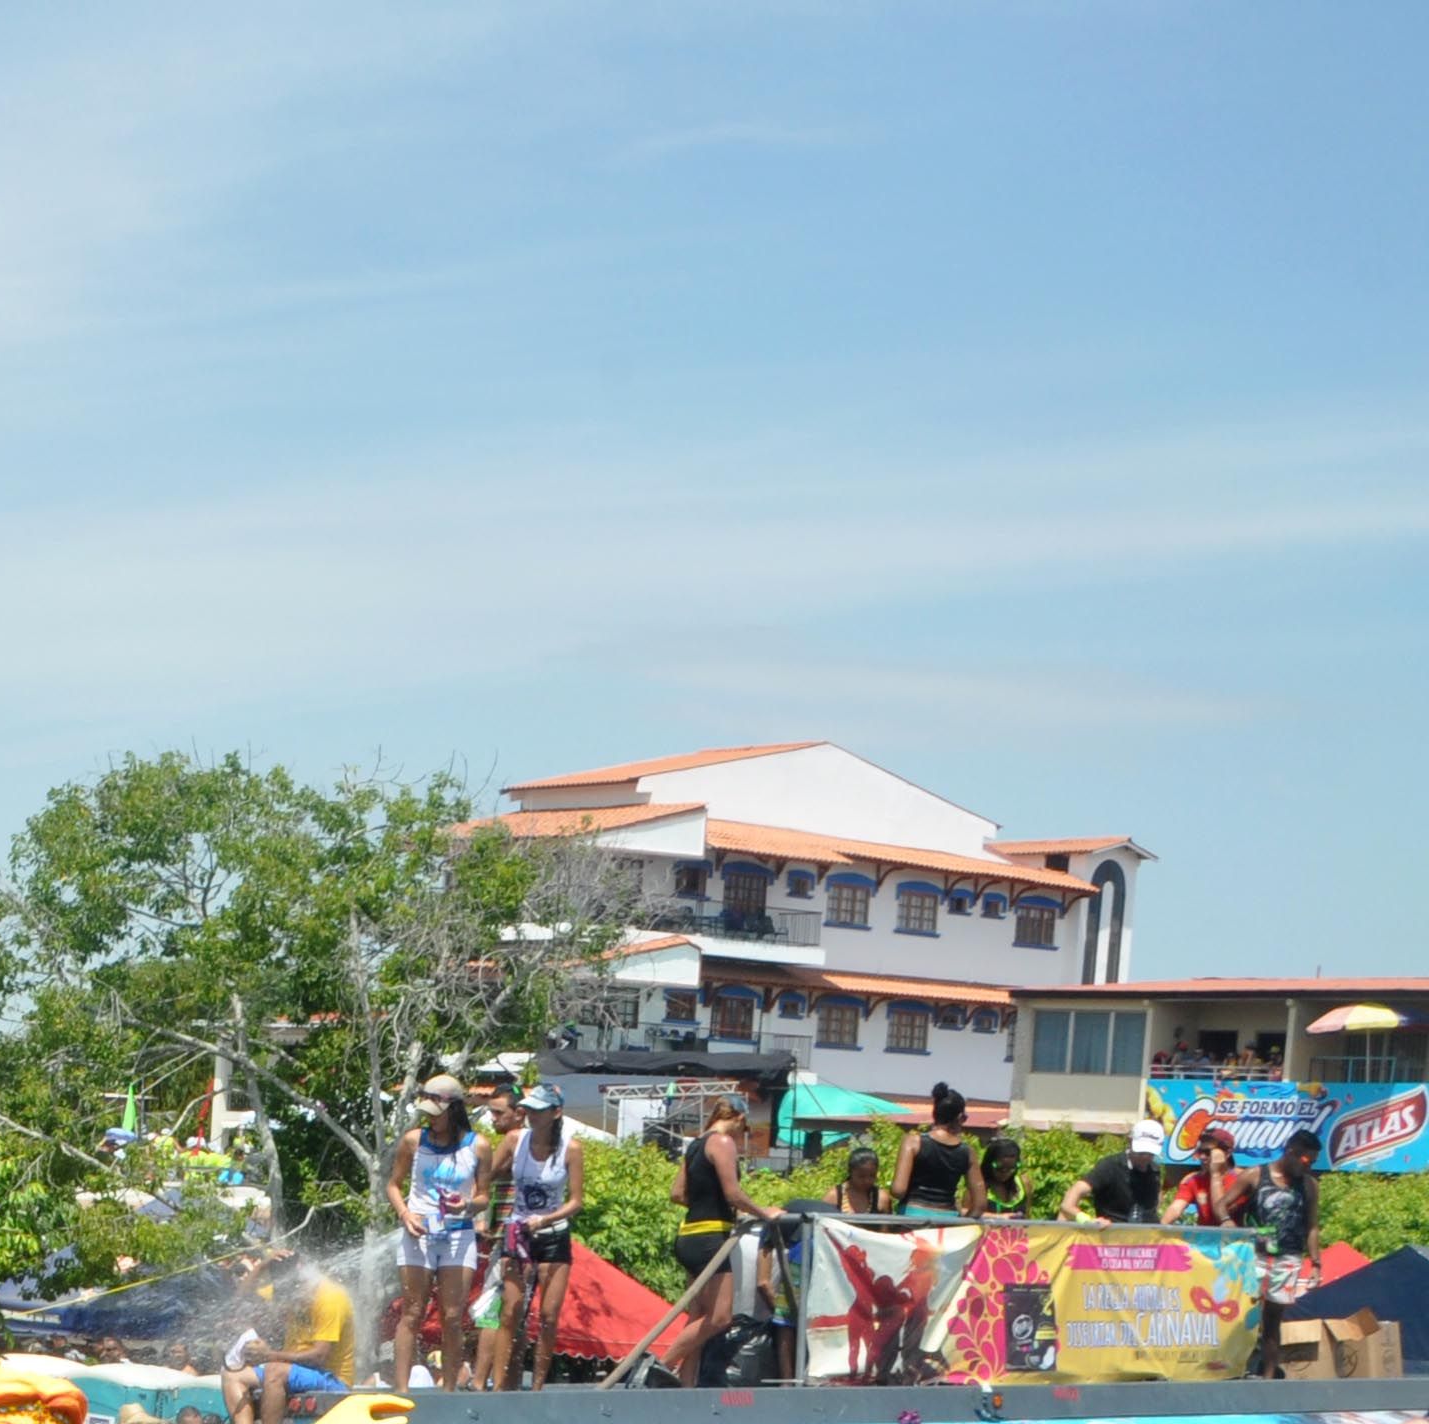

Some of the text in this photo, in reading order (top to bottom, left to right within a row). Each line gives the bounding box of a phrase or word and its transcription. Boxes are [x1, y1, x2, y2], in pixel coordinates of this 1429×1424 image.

[1218, 1100, 1238, 1114] SE
[1297, 1101, 1316, 1116] EL
[1336, 1106, 1418, 1158] ATLAS
[1135, 1311, 1220, 1347] CARNAVAL
